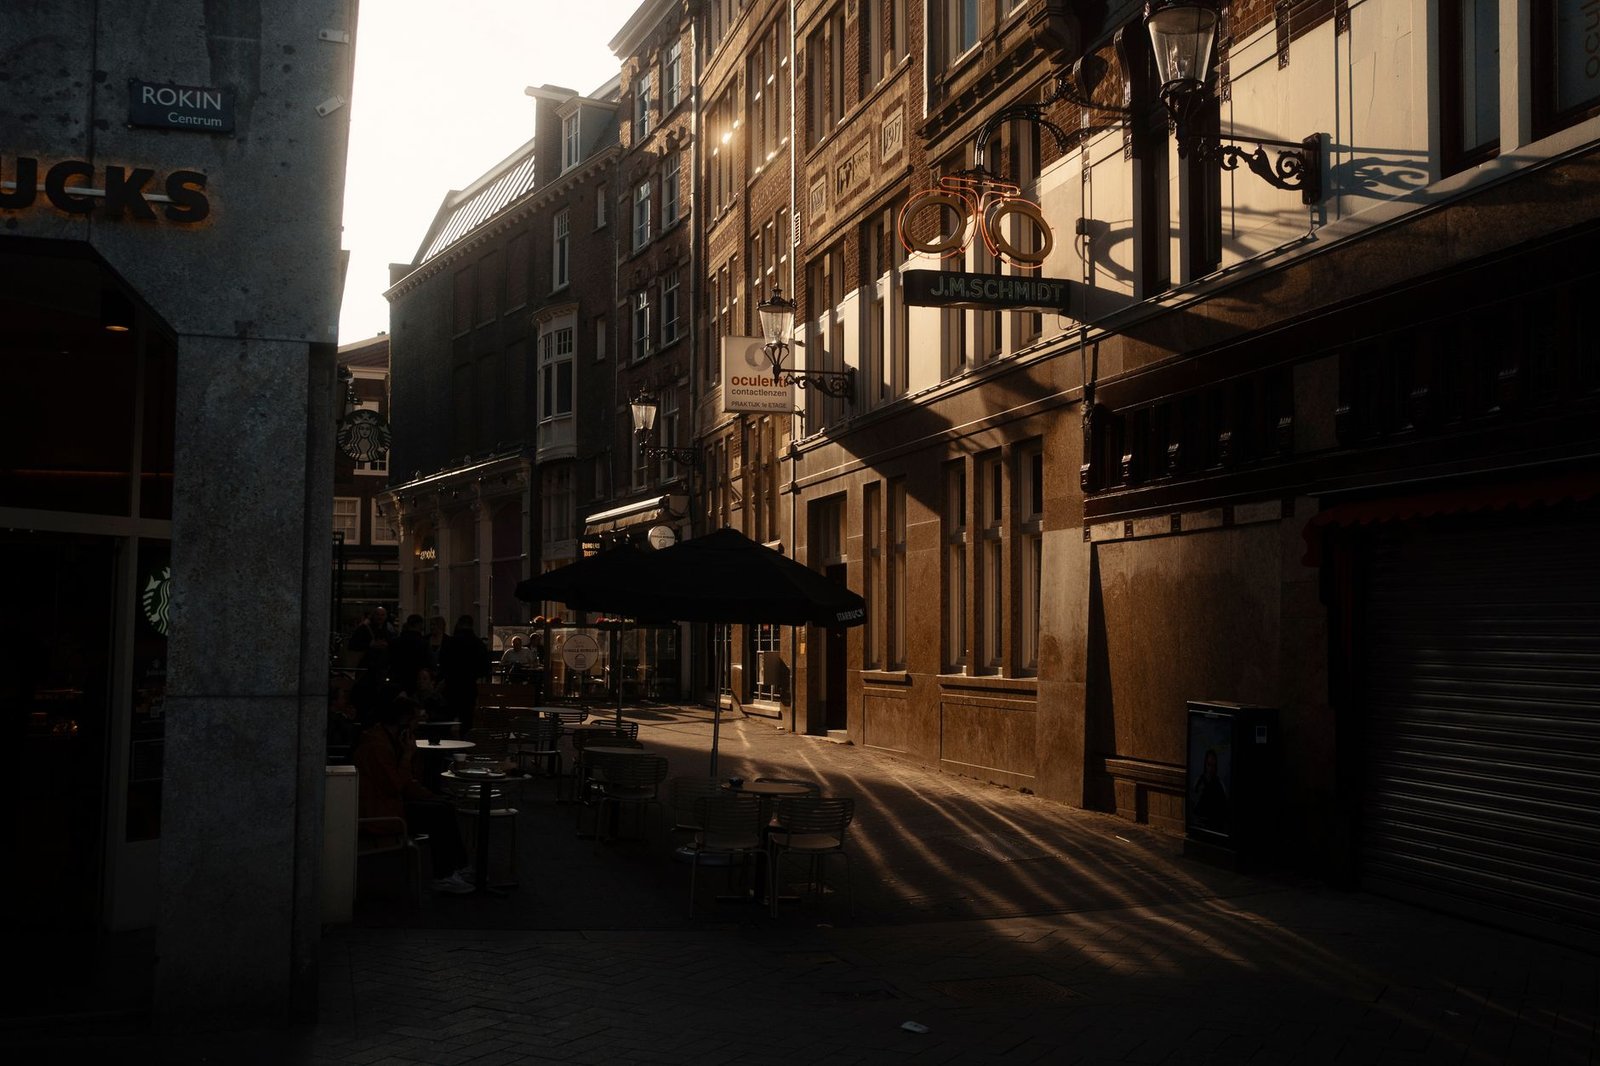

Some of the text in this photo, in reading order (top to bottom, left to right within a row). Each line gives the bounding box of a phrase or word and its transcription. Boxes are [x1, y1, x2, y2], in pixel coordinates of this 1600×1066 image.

[142, 86, 222, 110] ROKIN
[167, 112, 223, 126] Centrum
[731, 389, 787, 397] contactlenzen
